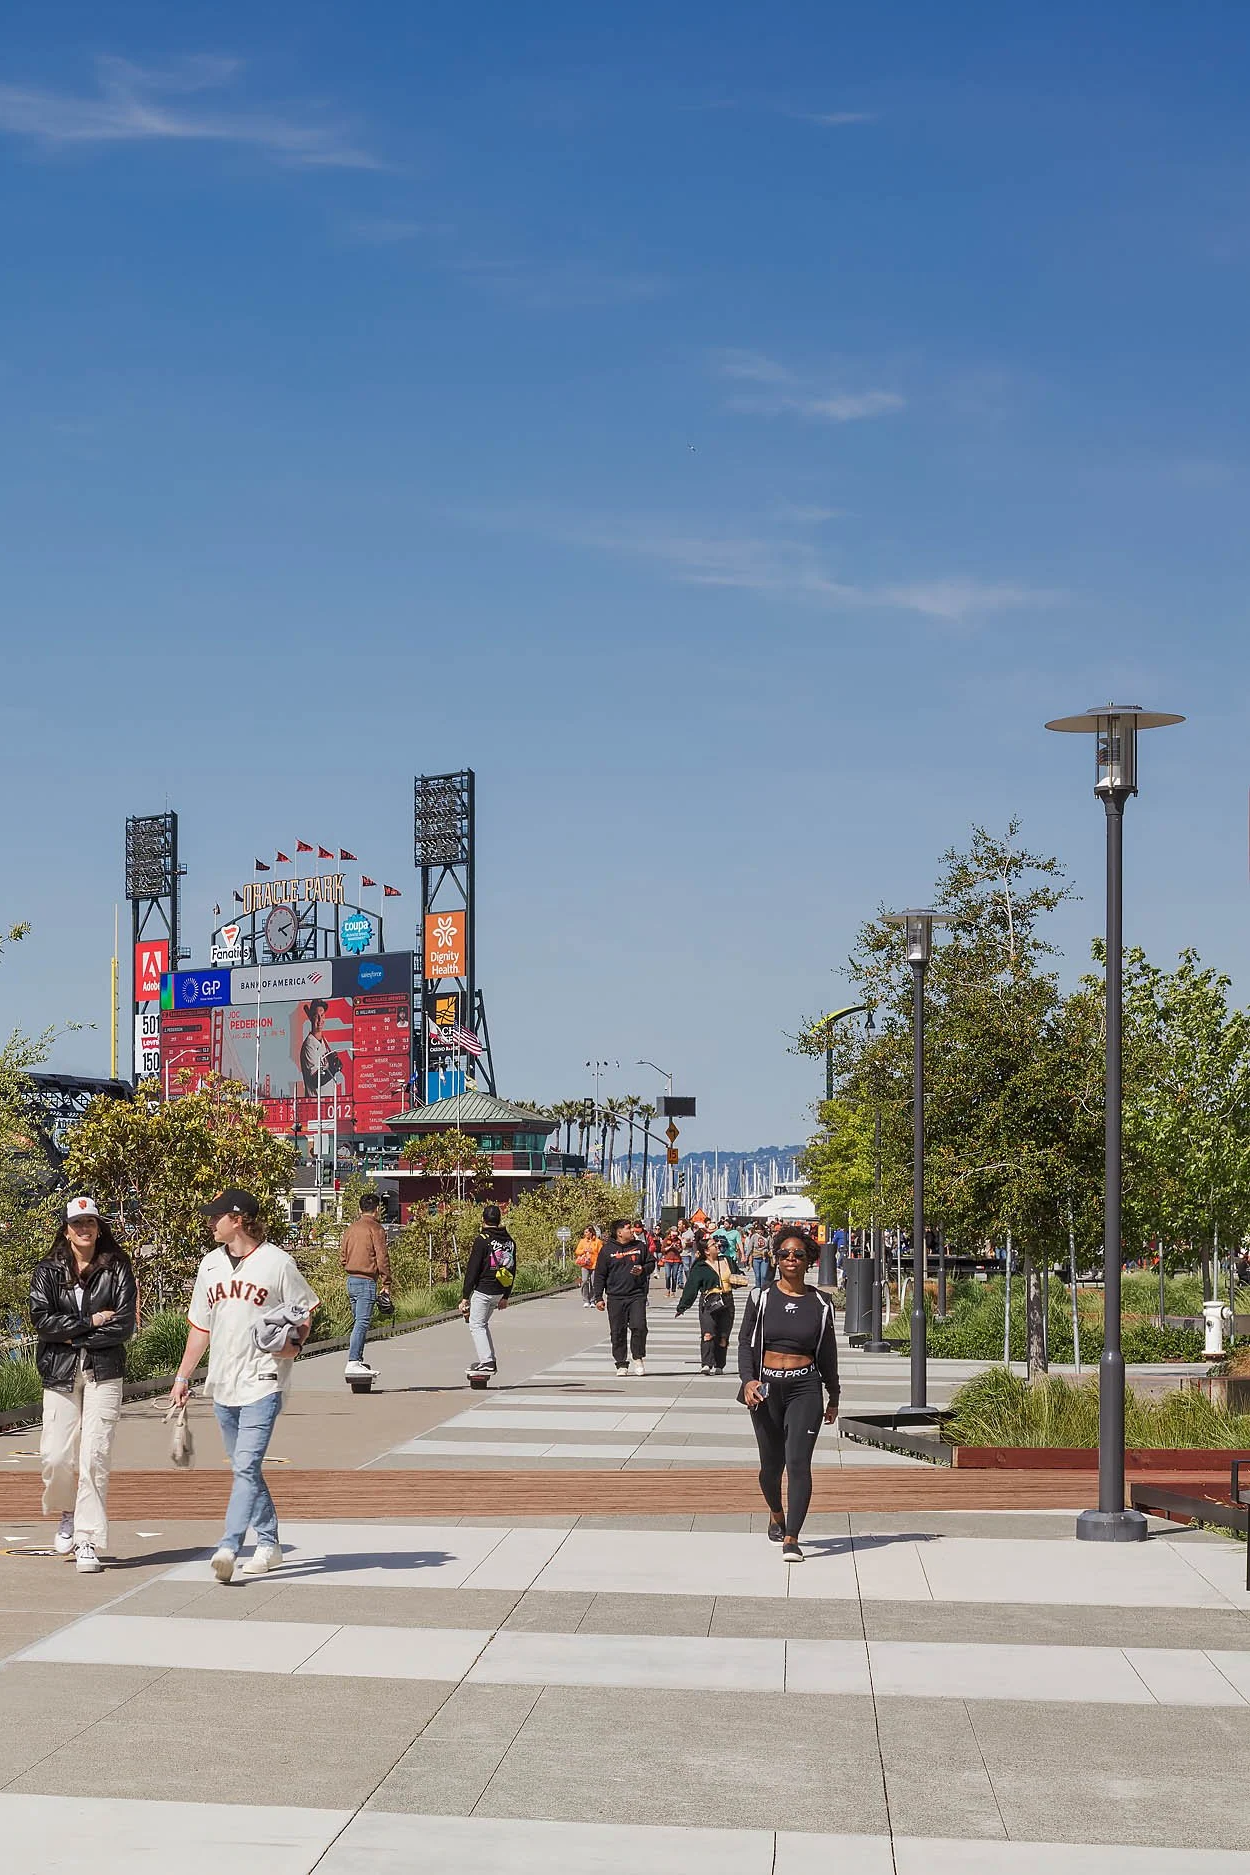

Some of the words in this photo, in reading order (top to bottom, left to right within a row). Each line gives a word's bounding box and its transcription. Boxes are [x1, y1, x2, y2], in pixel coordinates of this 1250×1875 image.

[242, 879, 300, 914] ORACLE
[304, 872, 346, 904] PARK
[345, 920, 369, 933] coupa
[430, 951, 459, 964] Dignity
[360, 971, 382, 979] salesforce
[432, 963, 458, 976] Health
[240, 981, 260, 990] BANK
[263, 980, 271, 988] OF
[273, 977, 306, 987] AMERICA
[142, 1016, 160, 1035] 501
[142, 1052, 160, 1072] 150
[669, 1149, 677, 1159] 15
[762, 1367, 784, 1378] NIKE
[784, 1368, 809, 1378] PRO
